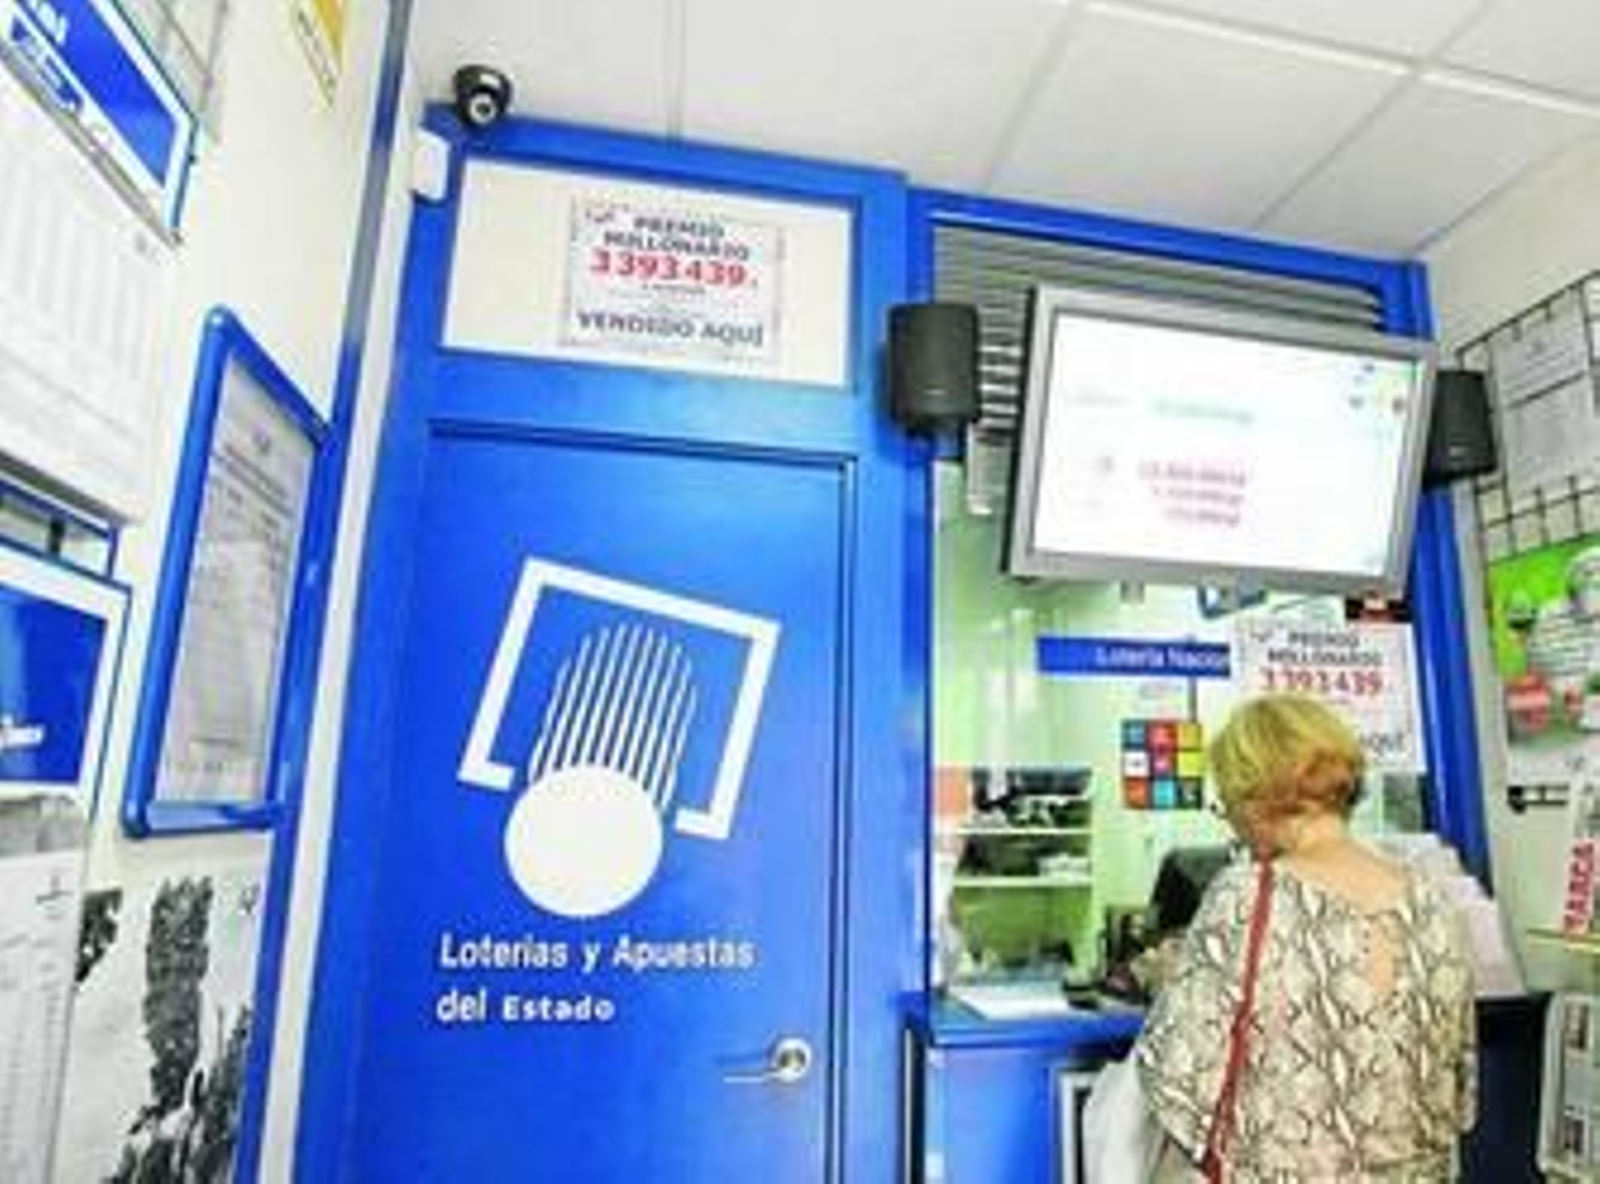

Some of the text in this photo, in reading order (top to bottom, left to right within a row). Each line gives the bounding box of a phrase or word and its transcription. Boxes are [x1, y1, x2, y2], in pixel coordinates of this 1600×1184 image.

[633, 214, 725, 239] PREMIO
[603, 230, 749, 263] MILLONARIO
[576, 311, 697, 338] VENDIDO
[582, 940, 601, 974] y
[612, 934, 756, 973] Apuestas
[436, 986, 615, 1023] del Estado
